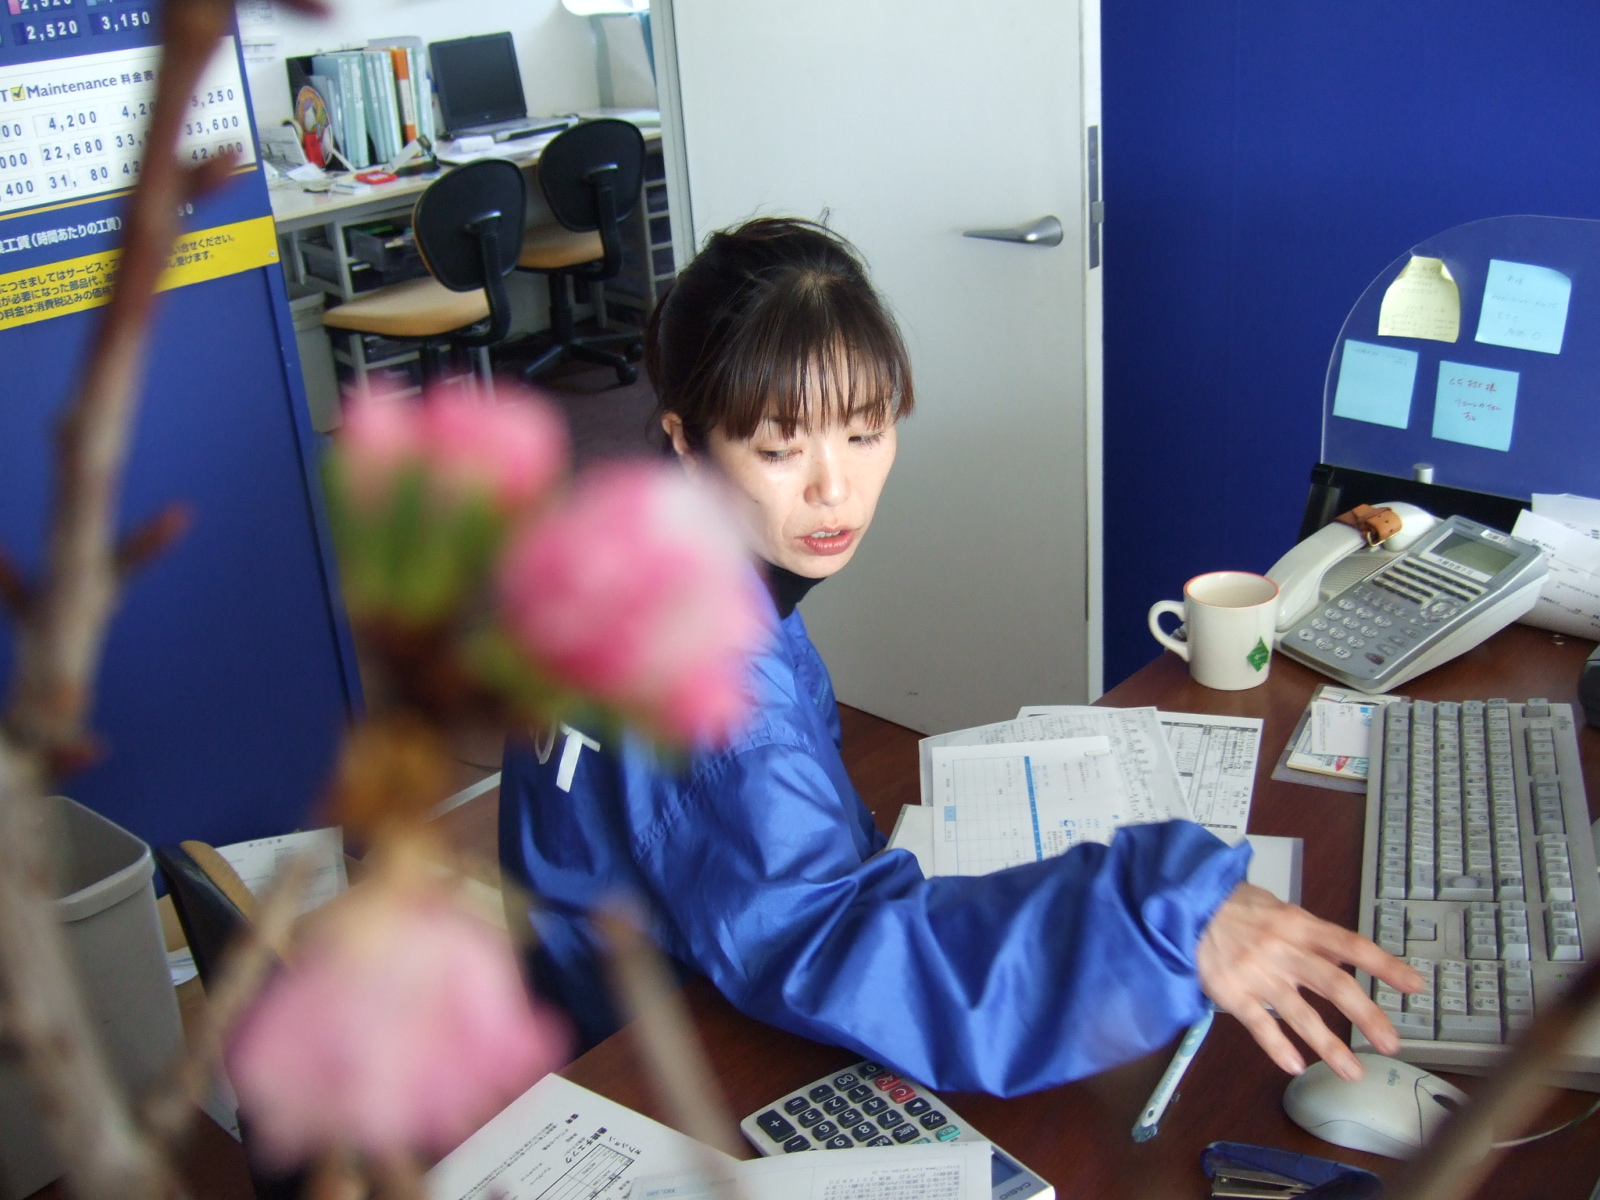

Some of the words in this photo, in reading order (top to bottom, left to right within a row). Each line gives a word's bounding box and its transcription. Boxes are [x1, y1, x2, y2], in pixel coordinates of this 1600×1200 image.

[26, 20, 78, 41] 2,520
[101, 11, 150, 32] 3,150
[26, 76, 118, 99] Maintenance
[120, 69, 154, 85] 料金表
[48, 111, 97, 131] 4,200
[191, 88, 234, 108] 5,250
[43, 138, 103, 160] 22,680
[186, 115, 239, 136] 33,600
[836, 1074, 854, 1085] 00
[877, 1074, 894, 1085] AC
[829, 1098, 841, 1107] 2
[867, 1100, 879, 1109] 4
[804, 1111, 815, 1120] 3
[843, 1112, 855, 1120] 5
[885, 1113, 896, 1122] 7
[818, 1124, 830, 1133] 6
[858, 1124, 870, 1133] 8
[833, 1137, 845, 1146] 9
[999, 1181, 1032, 1200] CASIO
